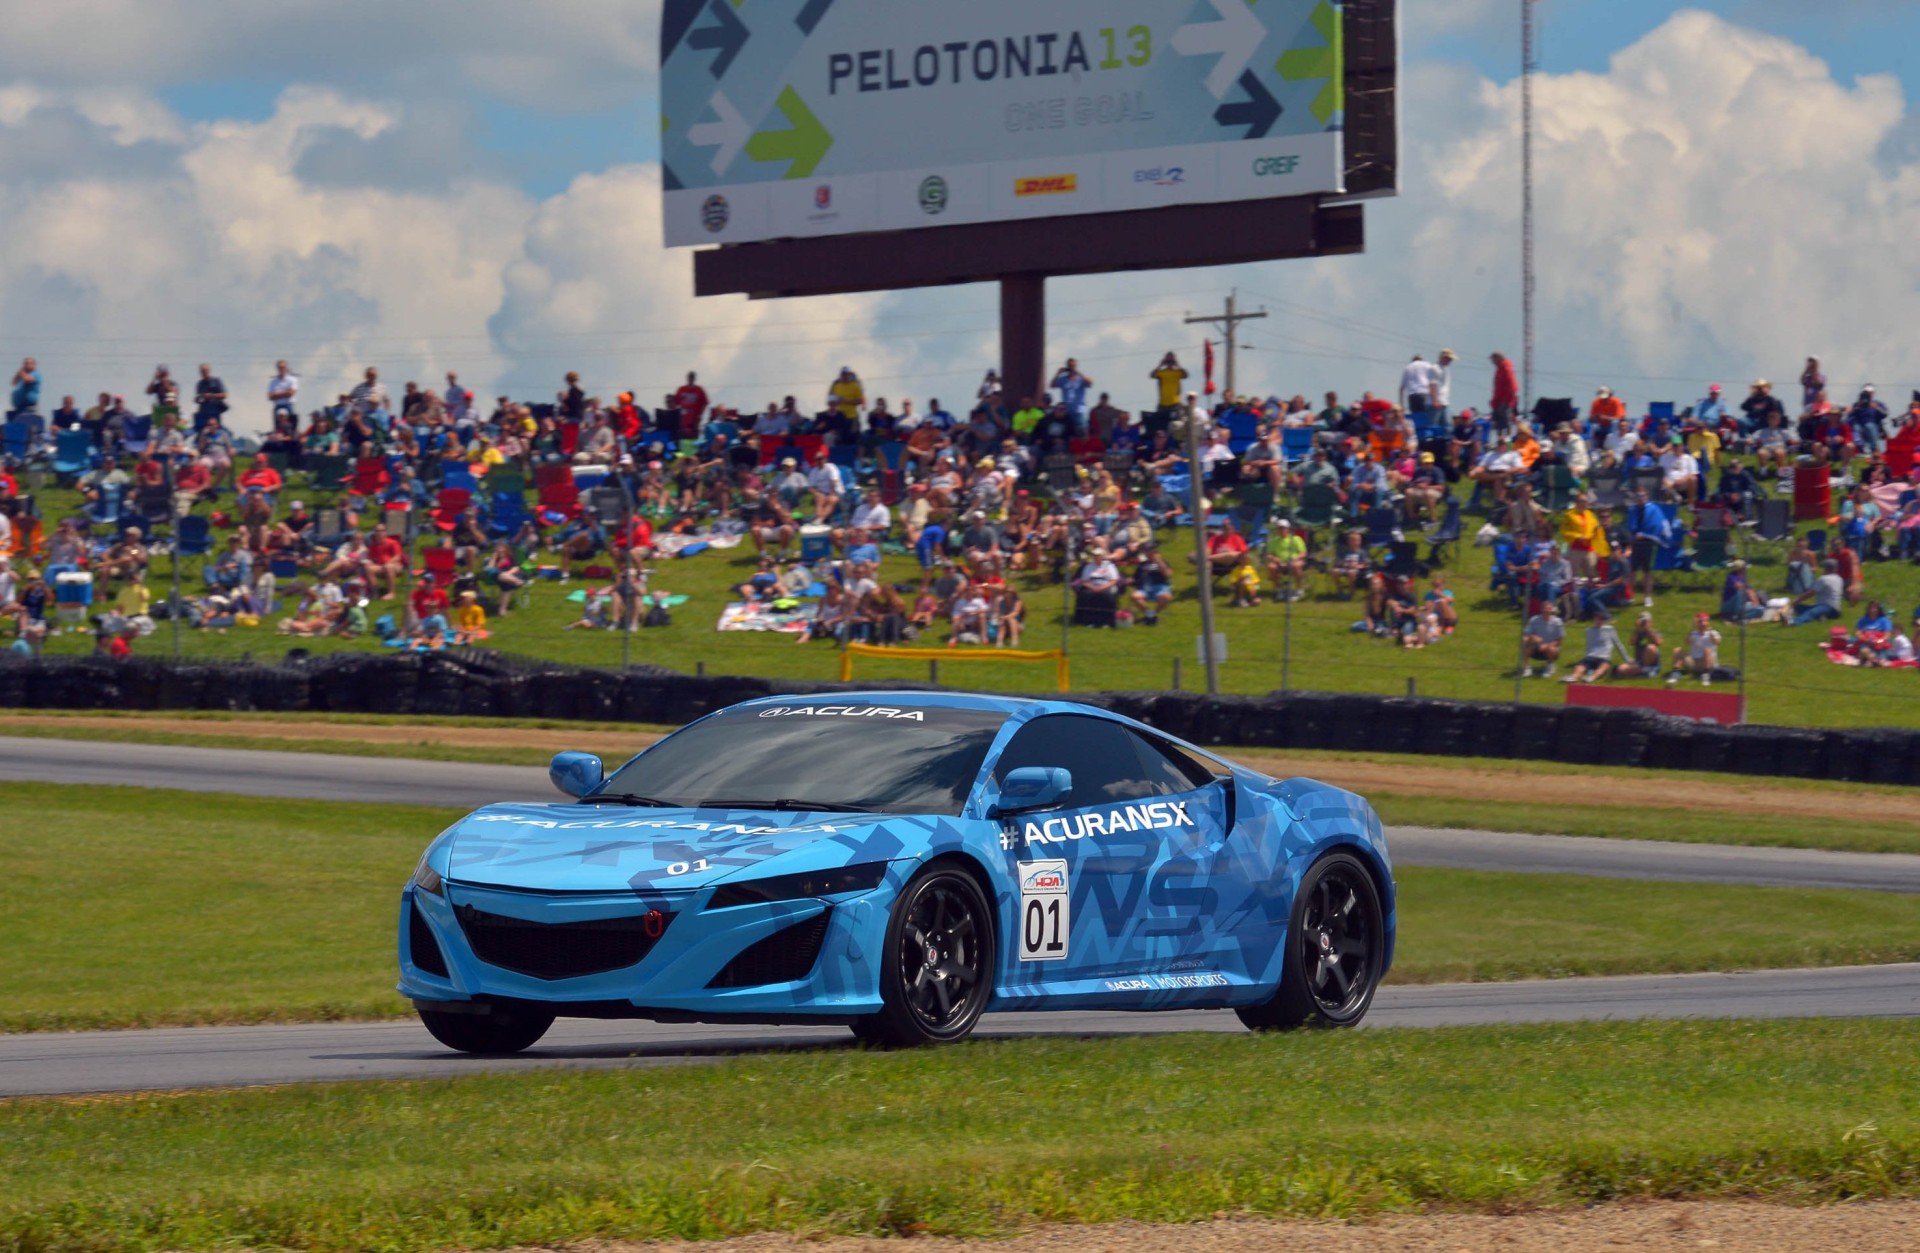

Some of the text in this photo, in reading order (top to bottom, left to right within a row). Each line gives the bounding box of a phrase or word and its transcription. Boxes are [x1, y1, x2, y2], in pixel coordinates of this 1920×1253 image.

[829, 24, 1152, 95] PELOTONIA 13
[1004, 91, 1155, 132] ONE GOAL
[1252, 155, 1300, 176] GREIF
[1023, 177, 1068, 193] DHL
[785, 706, 924, 721] ACURA
[666, 858, 713, 877] 01
[1025, 899, 1063, 953] 01
[1113, 973, 1229, 991] ACURA MOTORSPORTS
